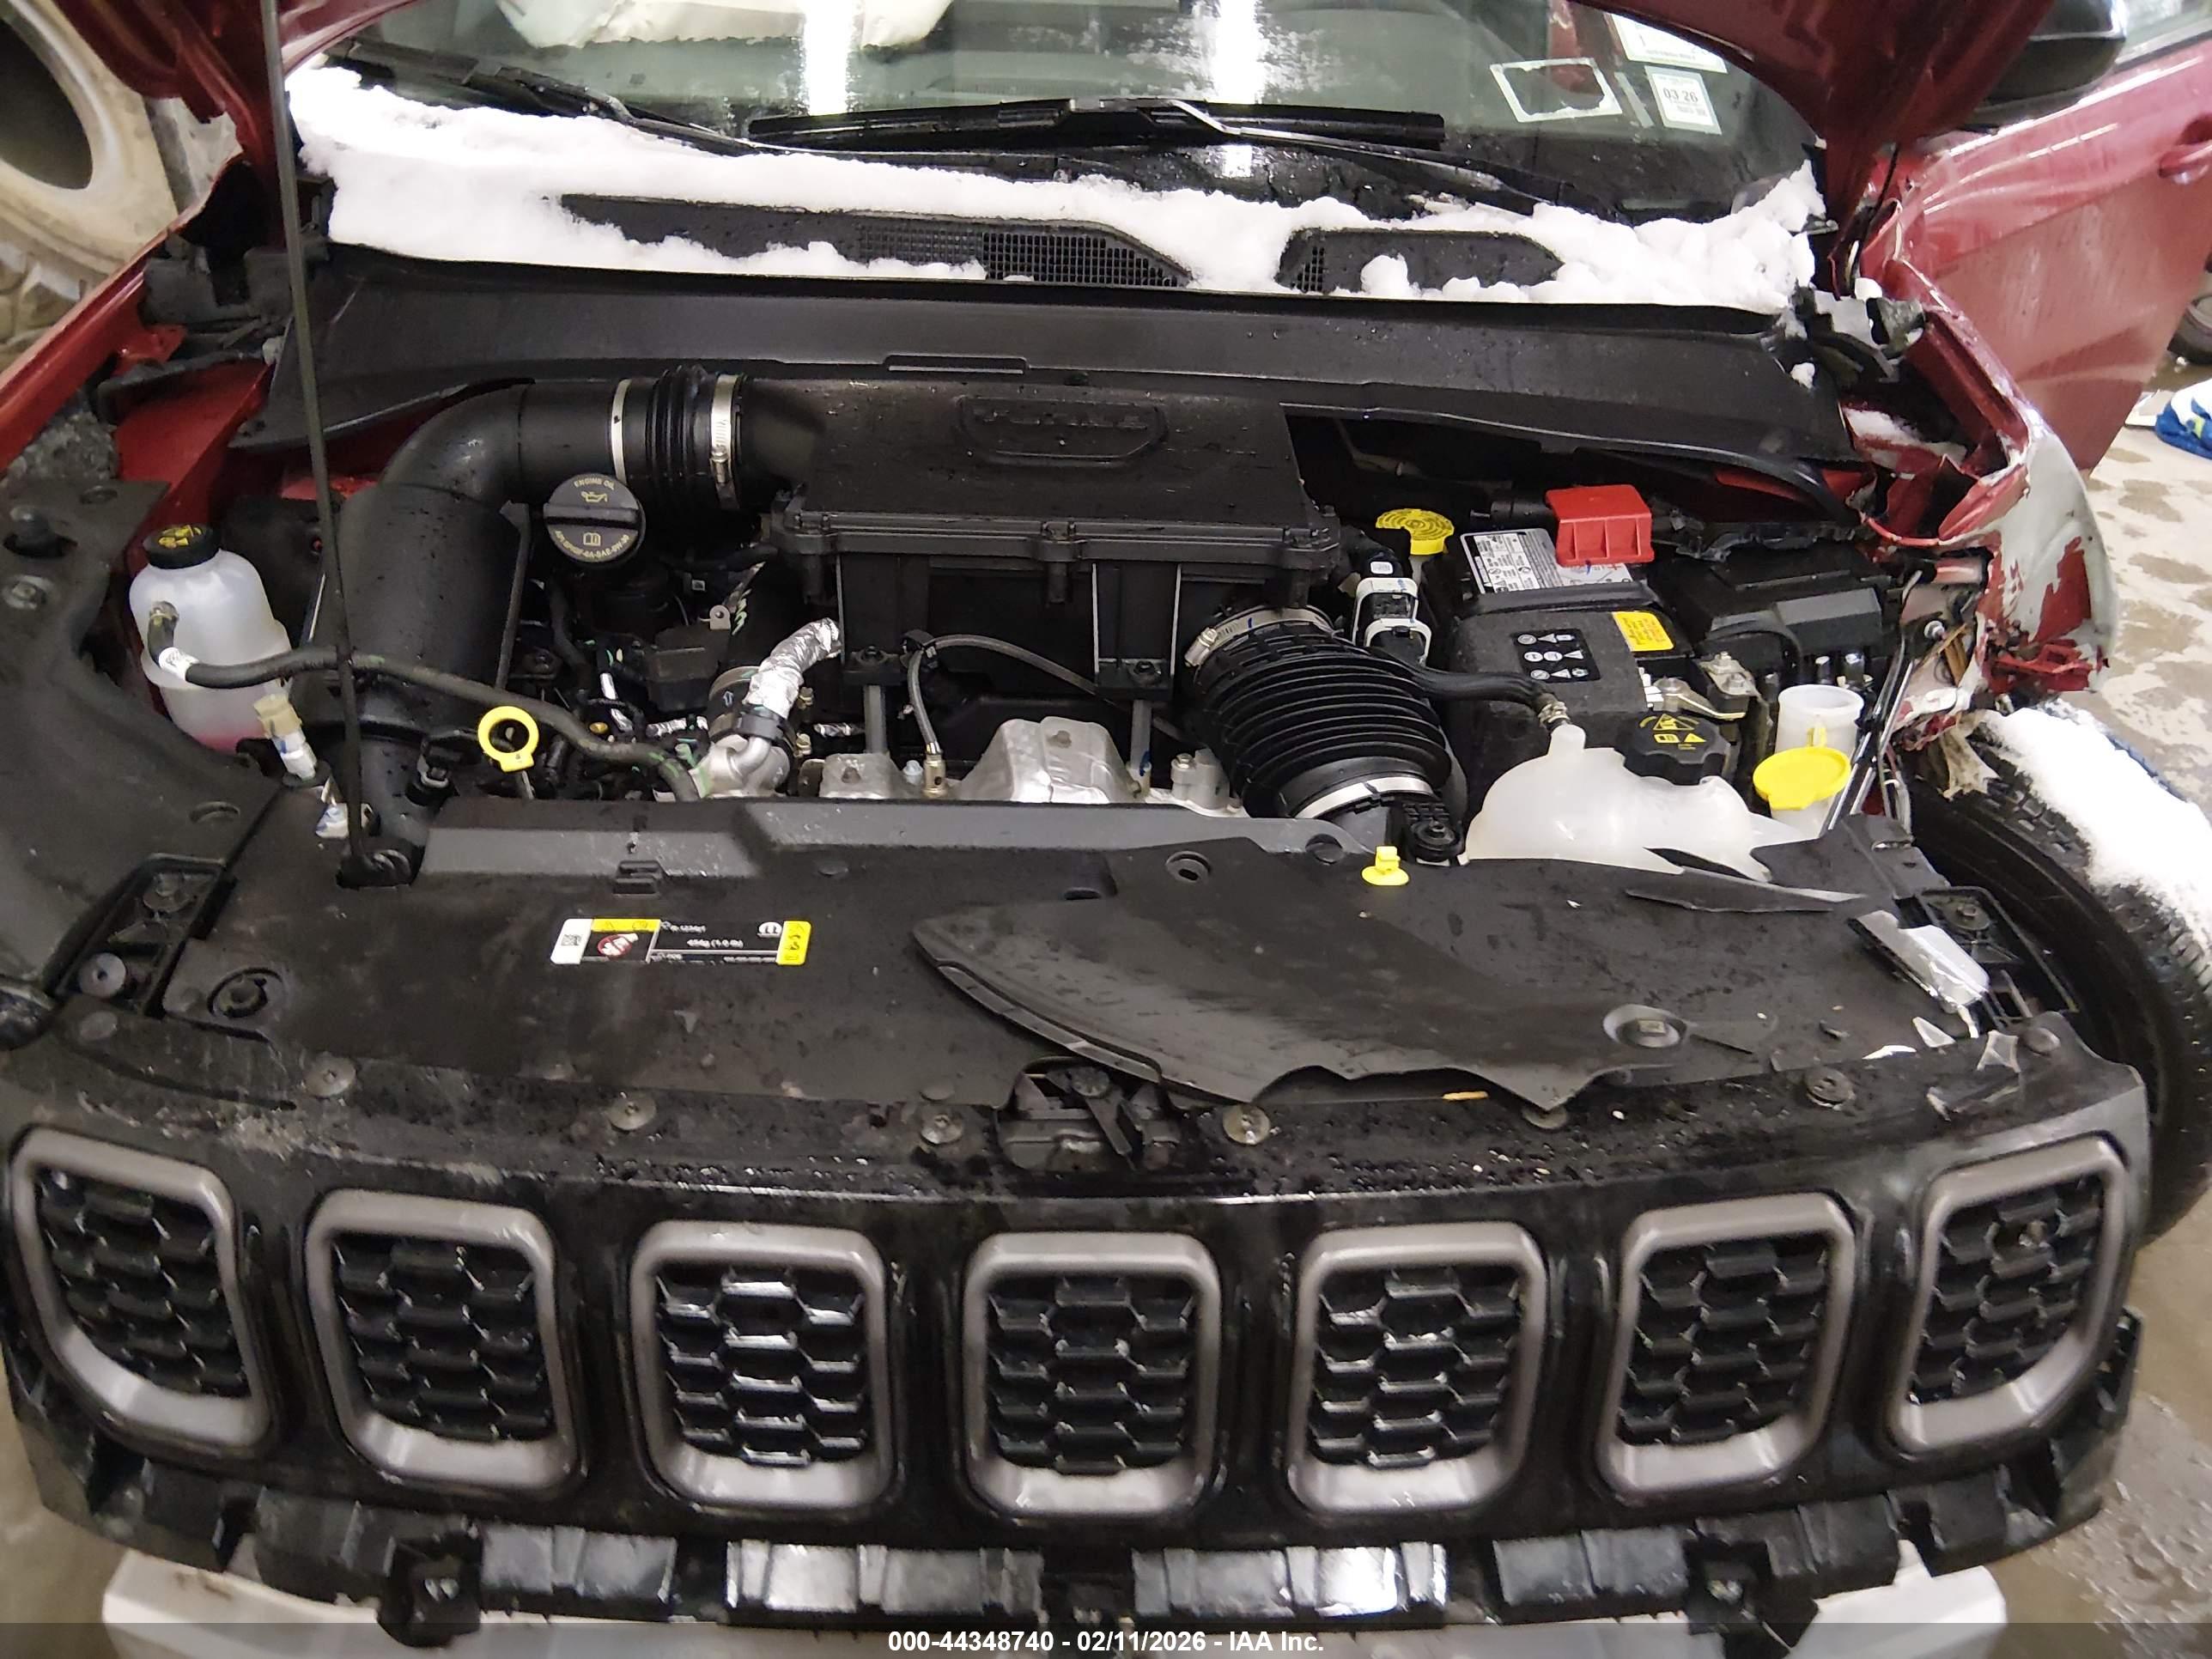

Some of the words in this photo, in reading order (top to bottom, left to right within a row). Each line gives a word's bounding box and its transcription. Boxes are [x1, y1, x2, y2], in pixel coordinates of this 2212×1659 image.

[1663, 88, 1679, 100] 03
[1681, 90, 1698, 103] 26
[574, 477, 602, 488] ENGINE
[603, 481, 615, 490] OIL
